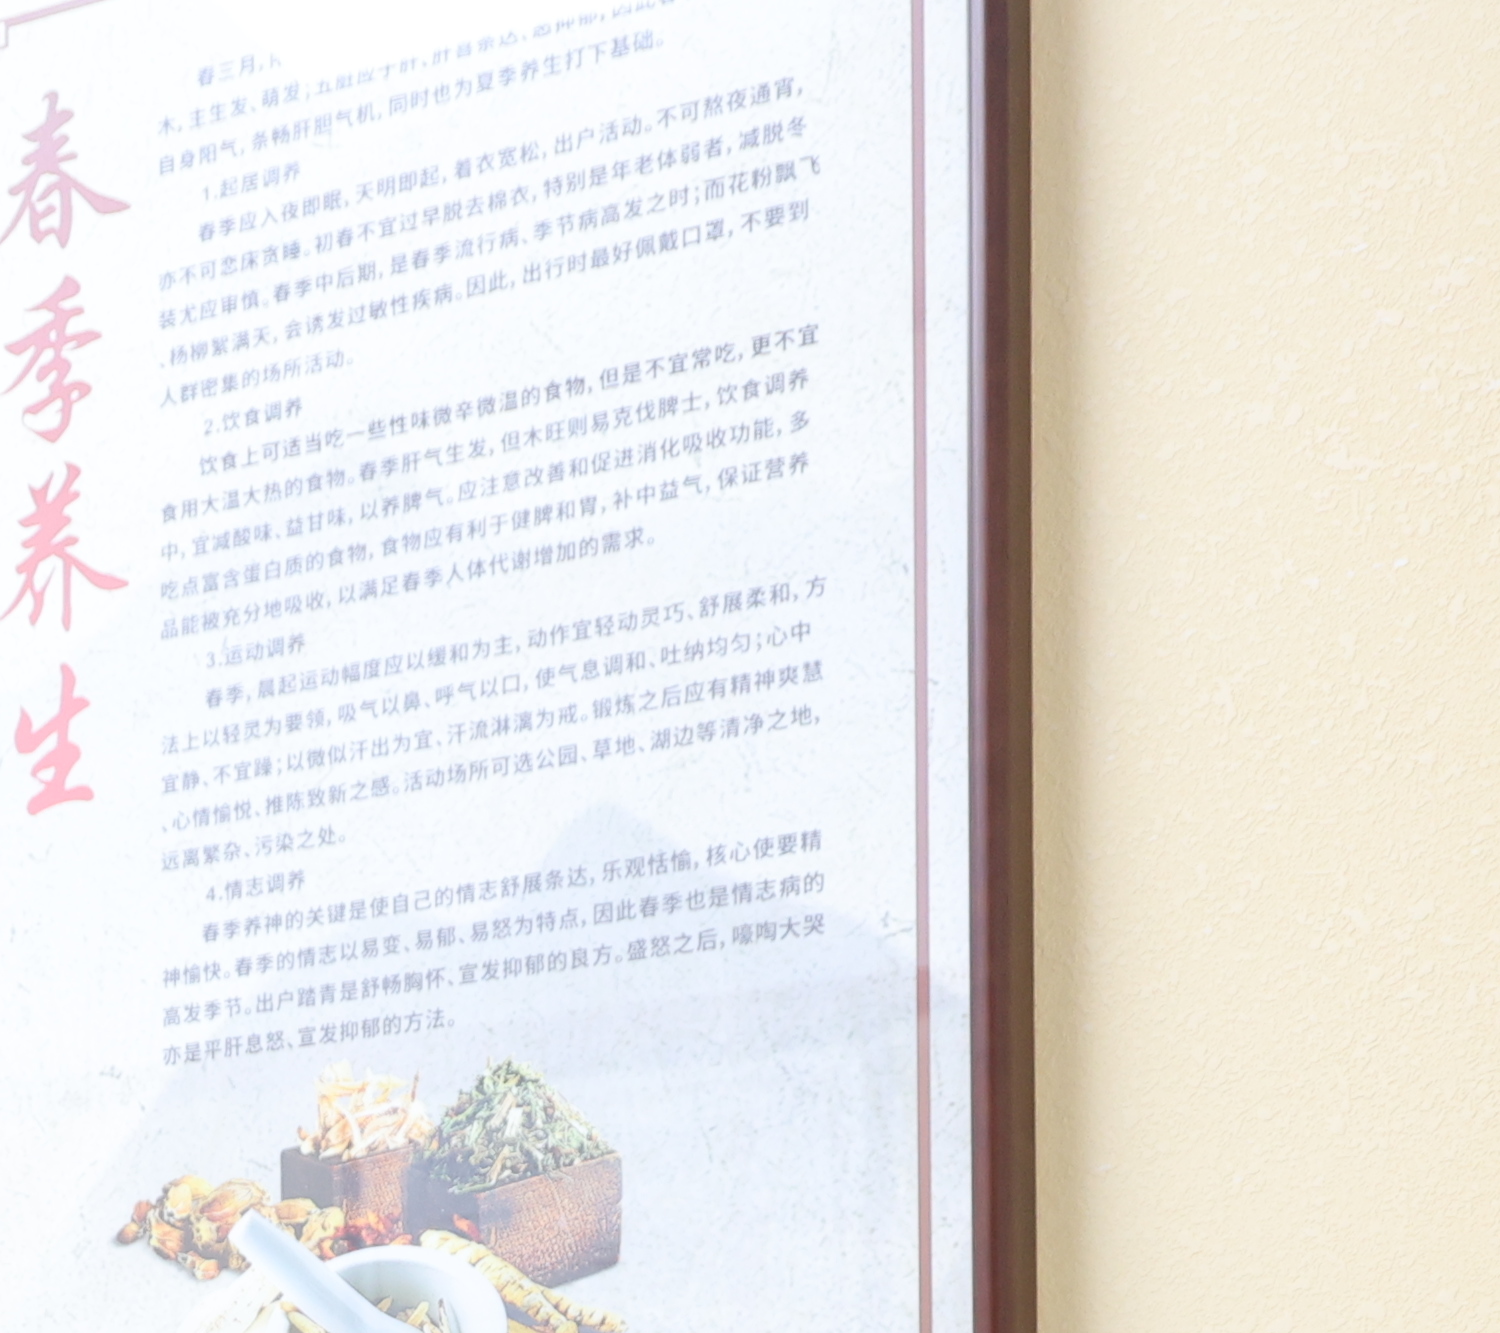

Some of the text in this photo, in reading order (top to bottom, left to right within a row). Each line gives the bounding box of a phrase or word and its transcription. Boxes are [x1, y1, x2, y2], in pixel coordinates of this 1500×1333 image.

[203, 161, 300, 201] 1.起居调养
[160, 349, 353, 408] 人群密集的场所活动。
[204, 396, 303, 437] 2.饮食调养
[207, 633, 305, 668] 3.运动调养
[162, 826, 345, 871] 远离繁杂、污染之处。
[206, 869, 305, 902] 4.情志调养
[163, 1009, 454, 1066] 亦是平肝息怒、宣发抑郁的方法。
